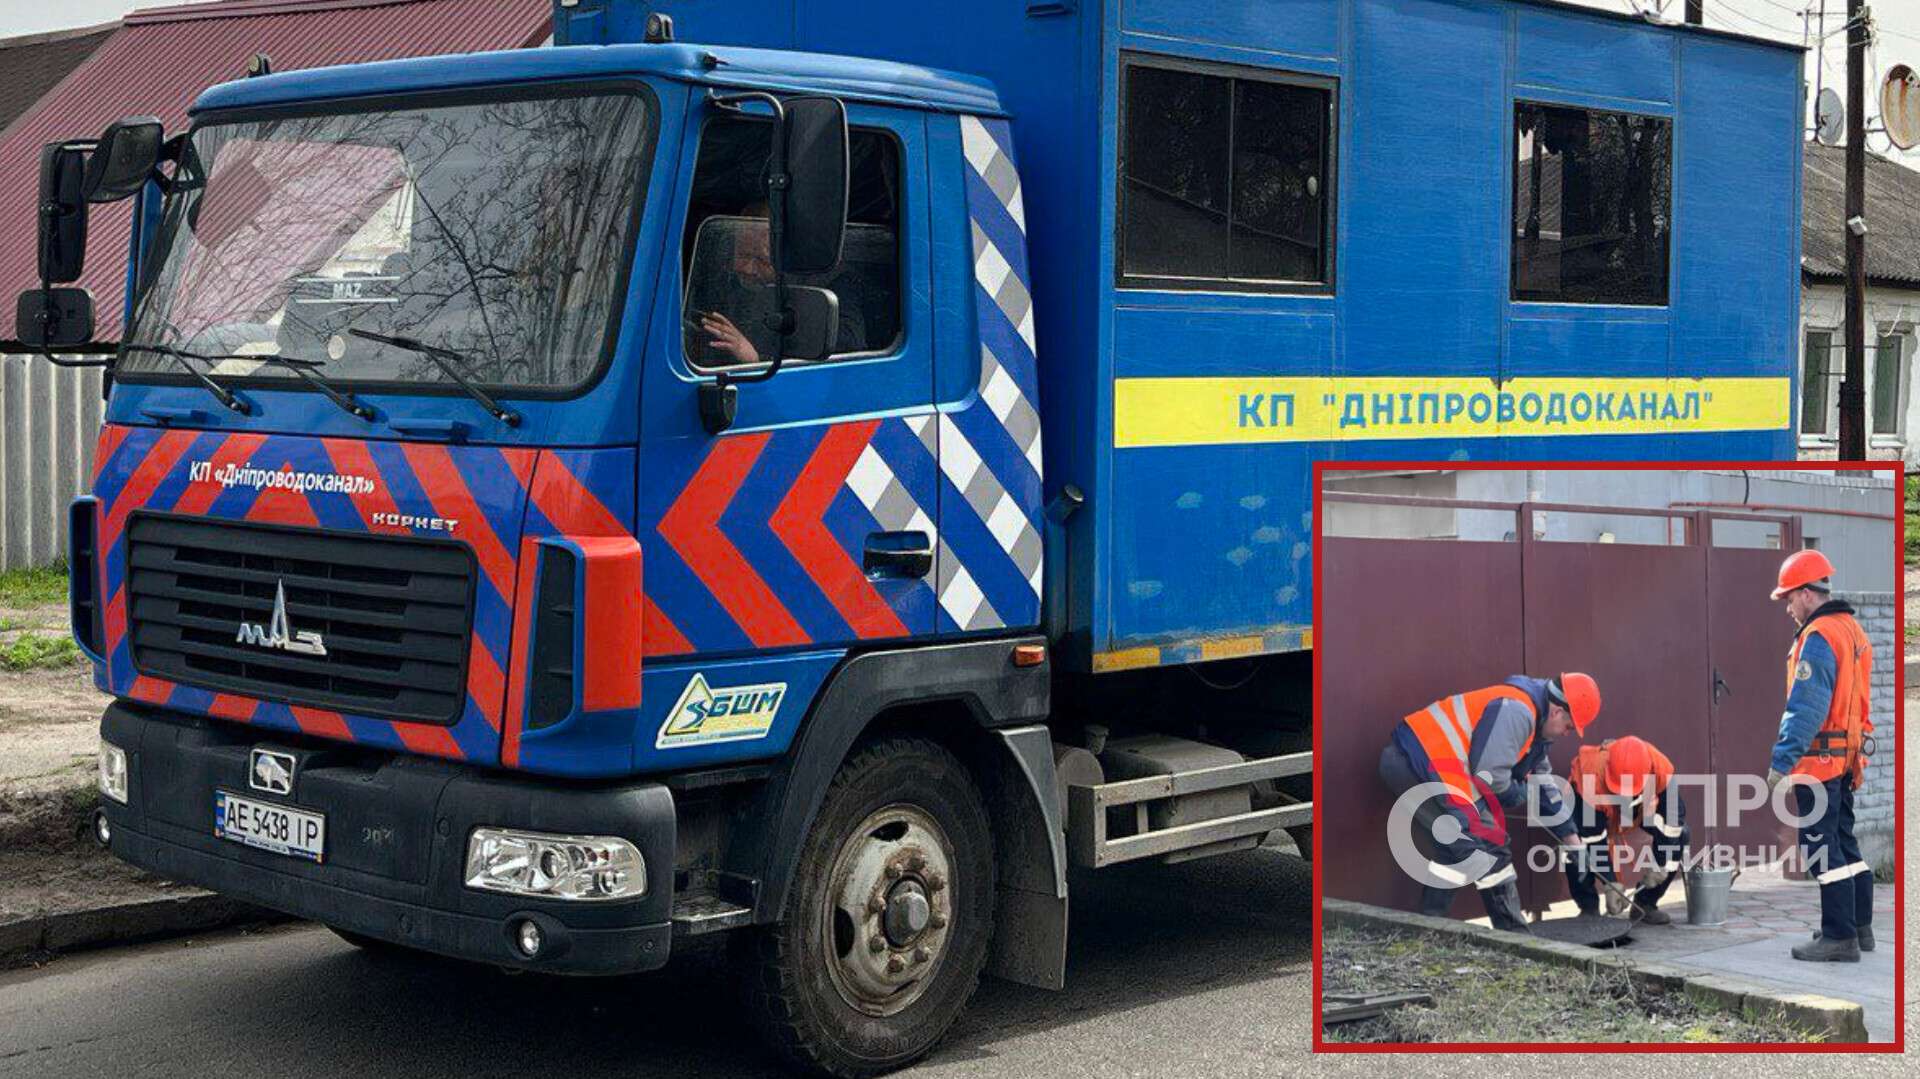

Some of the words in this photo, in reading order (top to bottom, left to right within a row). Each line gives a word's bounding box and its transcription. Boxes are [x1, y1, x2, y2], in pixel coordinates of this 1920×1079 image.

[332, 283, 362, 298] MAZ
[1238, 394, 1295, 427] КП
[1323, 391, 1713, 429] "ДНІПРОВОДОКАНАЛ"
[189, 461, 211, 481] КП
[214, 462, 374, 494] «Дніпроводоканал»
[372, 512, 458, 532] КОРНЕТ
[253, 808, 289, 842] 5438
